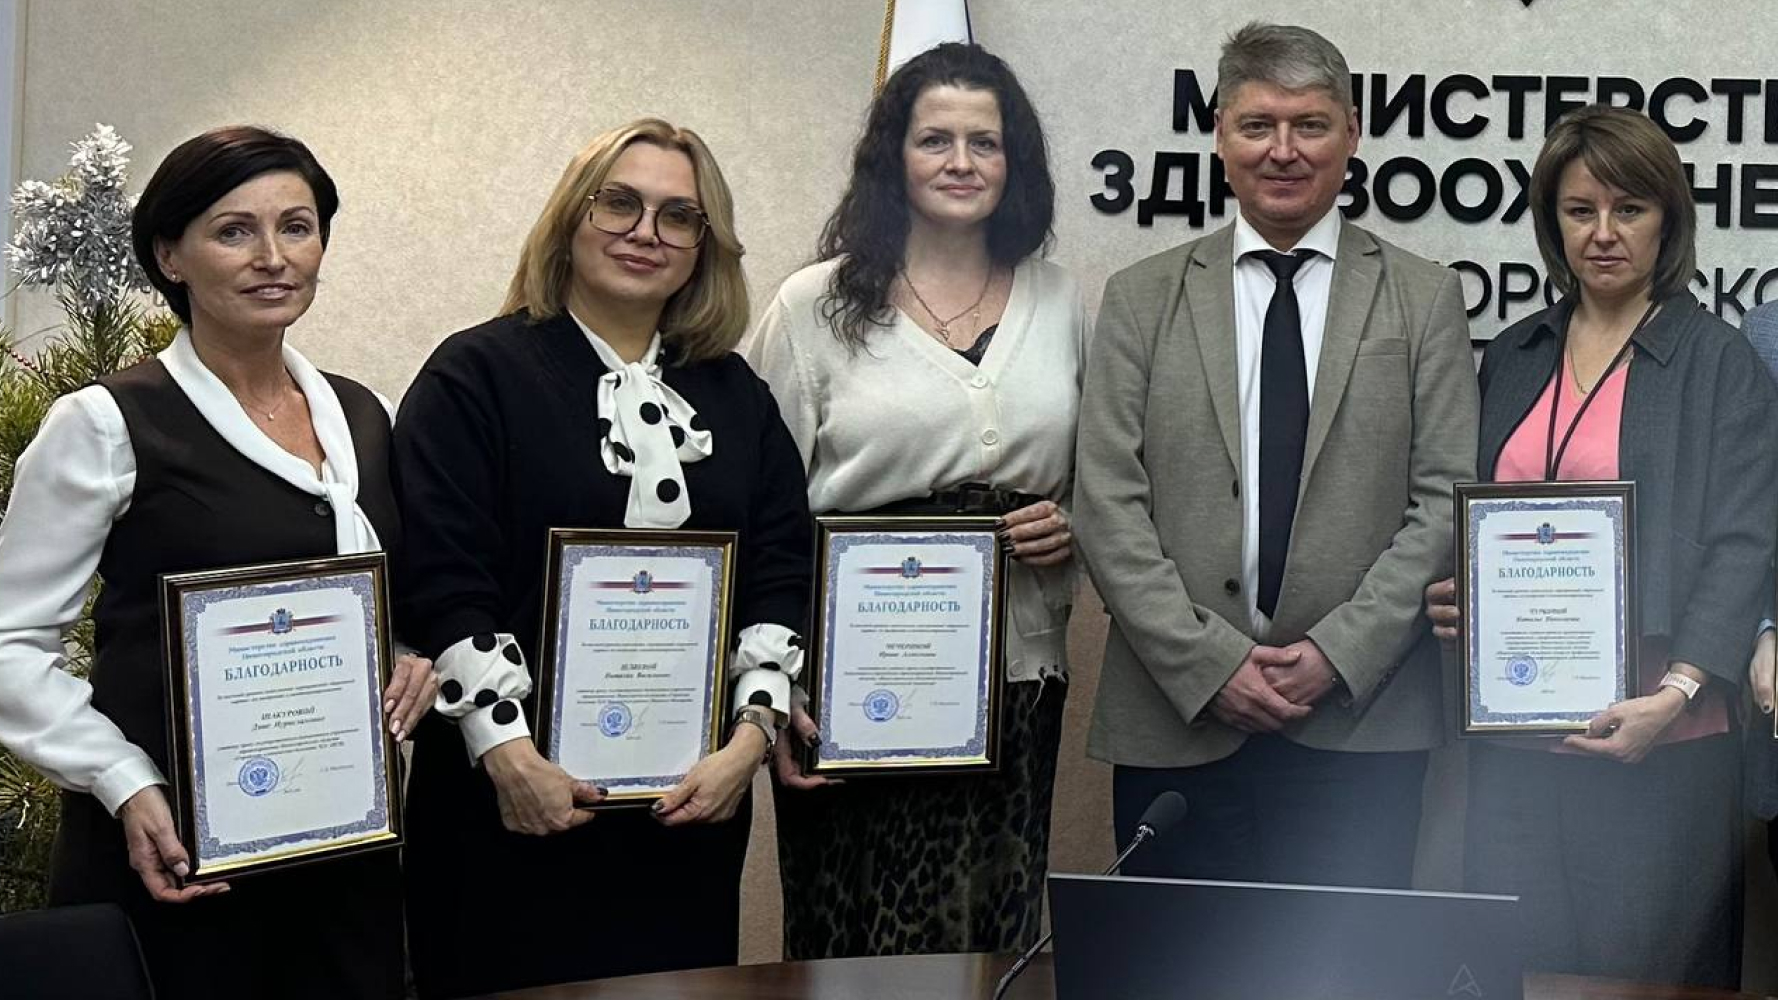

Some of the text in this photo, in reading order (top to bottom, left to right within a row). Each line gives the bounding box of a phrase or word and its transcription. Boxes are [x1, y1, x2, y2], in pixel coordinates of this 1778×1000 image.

[1499, 565, 1596, 579] БЛАГОДАРНОСТЬ
[857, 600, 961, 614] БЛАГОДАРНОСТЬ
[589, 616, 690, 631] БЛАГОДАРНОСТЬ
[224, 654, 343, 681] БЛАГОДАРНОСТЬ
